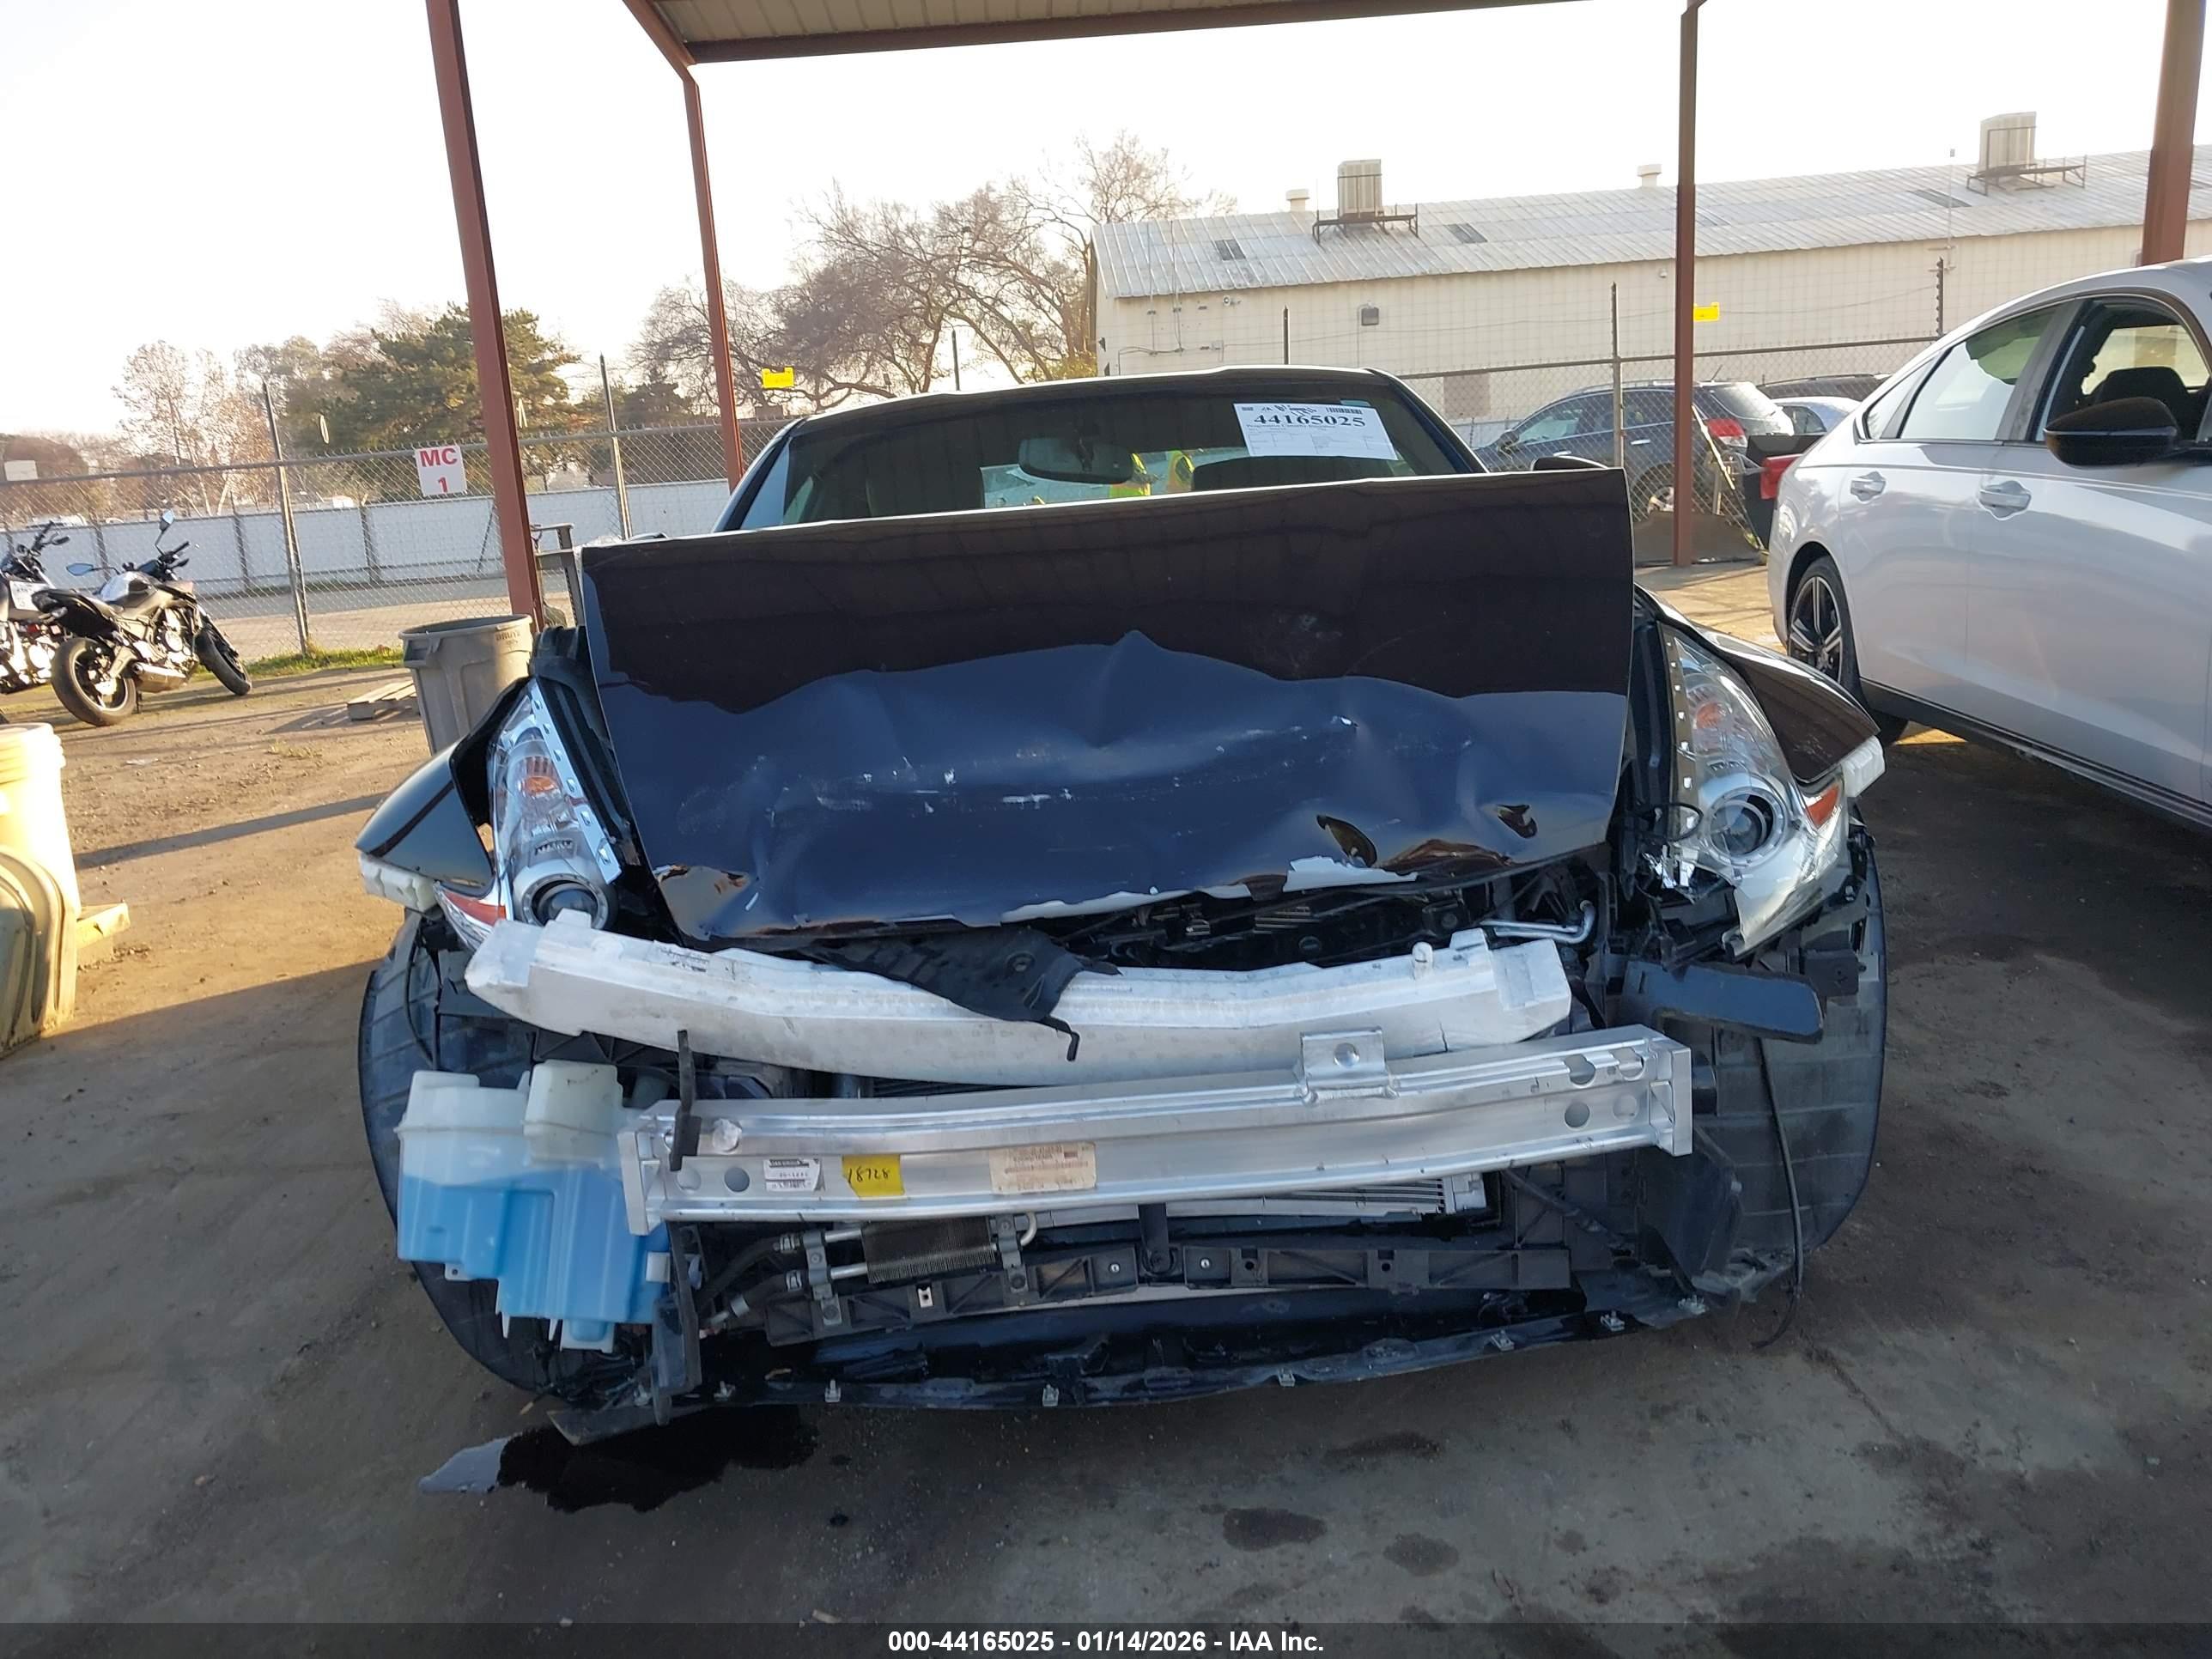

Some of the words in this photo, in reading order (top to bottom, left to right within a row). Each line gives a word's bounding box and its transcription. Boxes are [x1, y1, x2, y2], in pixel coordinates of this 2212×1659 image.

[1254, 415, 1365, 427] 44165025
[420, 447, 458, 467] MC
[438, 477, 448, 493] 1
